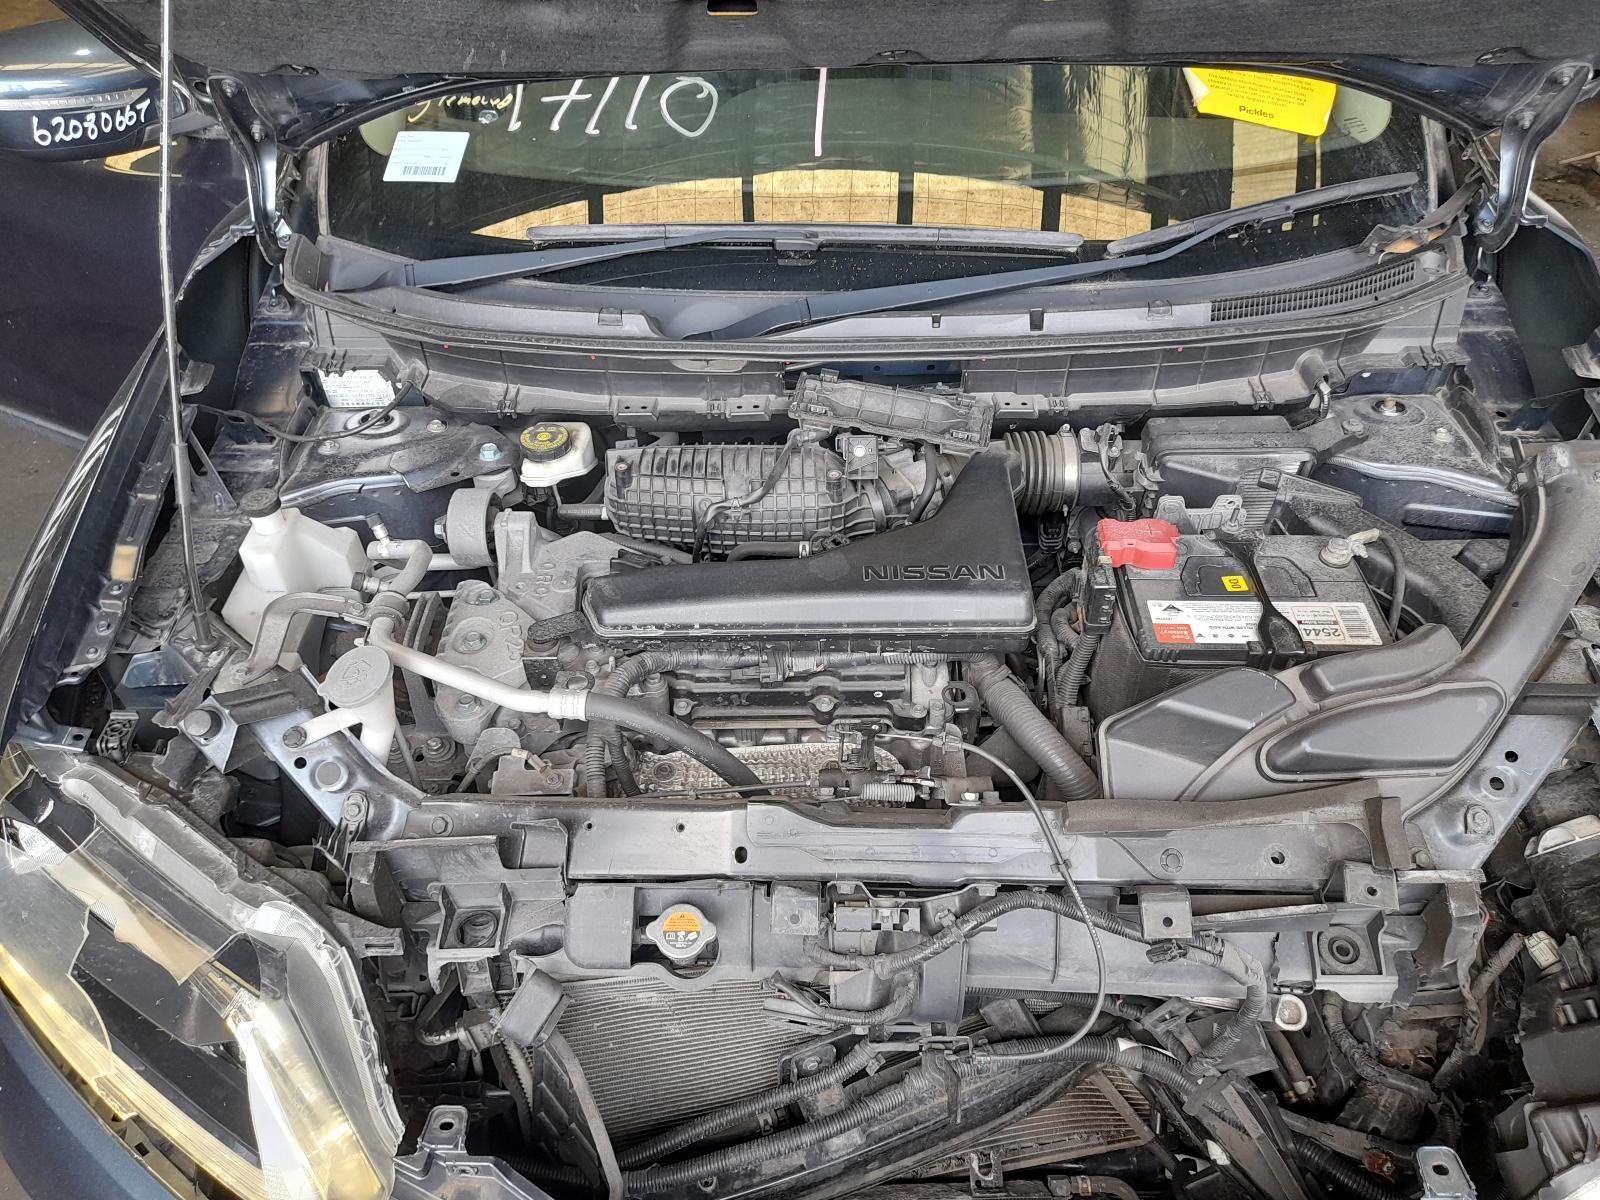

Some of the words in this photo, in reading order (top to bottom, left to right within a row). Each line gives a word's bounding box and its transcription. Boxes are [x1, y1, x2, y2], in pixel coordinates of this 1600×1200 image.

[1239, 104, 1275, 119] Pickles
[863, 564, 1006, 582] NISSAN
[1302, 627, 1341, 637] 2544
